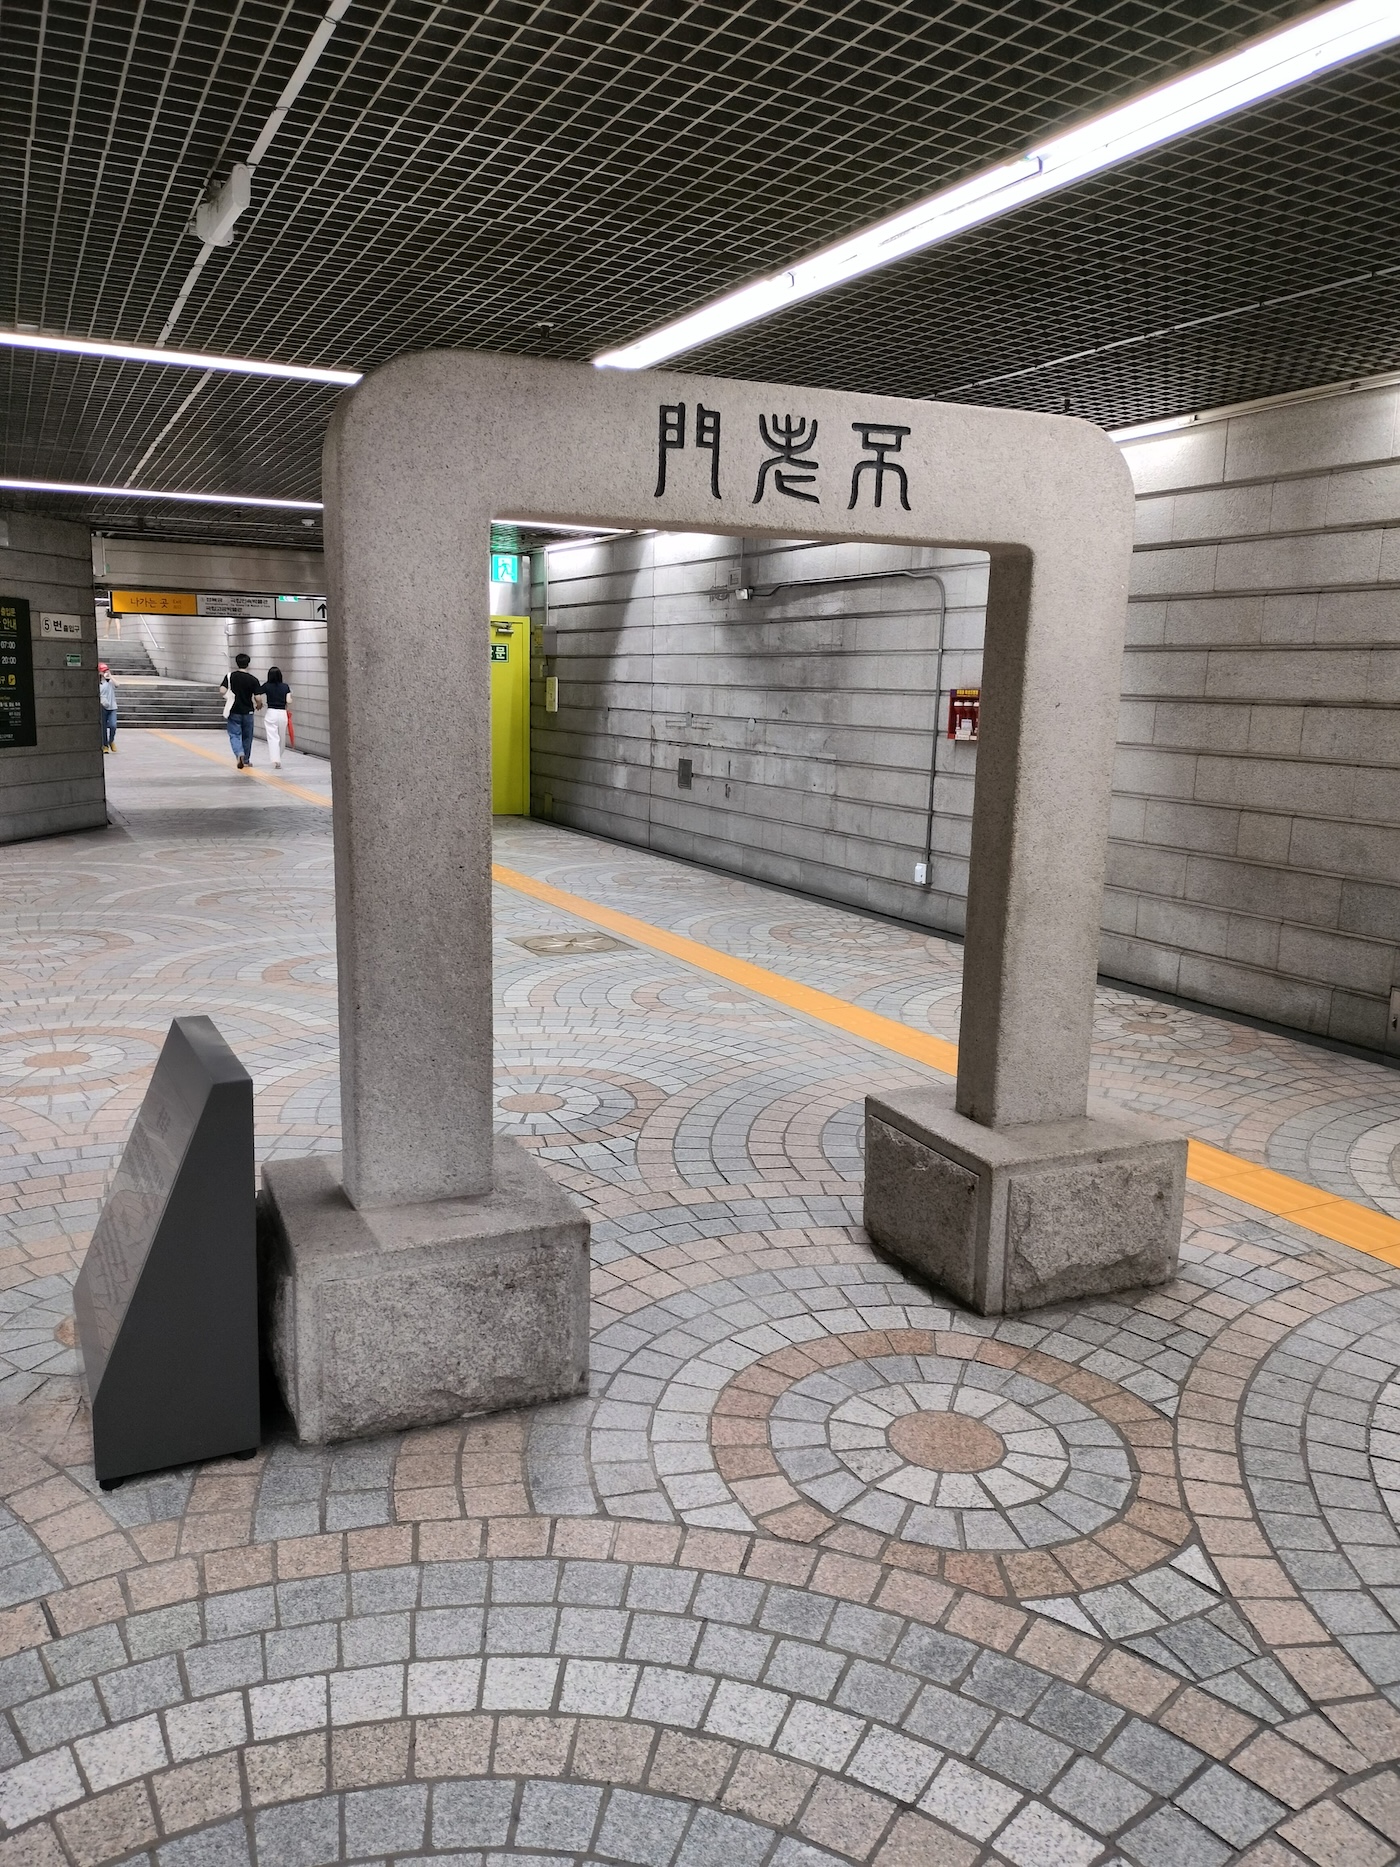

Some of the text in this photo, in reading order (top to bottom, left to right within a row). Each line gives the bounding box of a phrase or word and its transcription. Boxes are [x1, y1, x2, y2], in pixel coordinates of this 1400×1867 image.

[130, 597, 157, 608] 나가는
[160, 598, 169, 608] 곳
[2, 618, 17, 630] 안내
[53, 620, 62, 631] 번
[63, 625, 80, 633] 출입구
[0, 640, 16, 650] 07:00
[1, 656, 17, 665] 20:00
